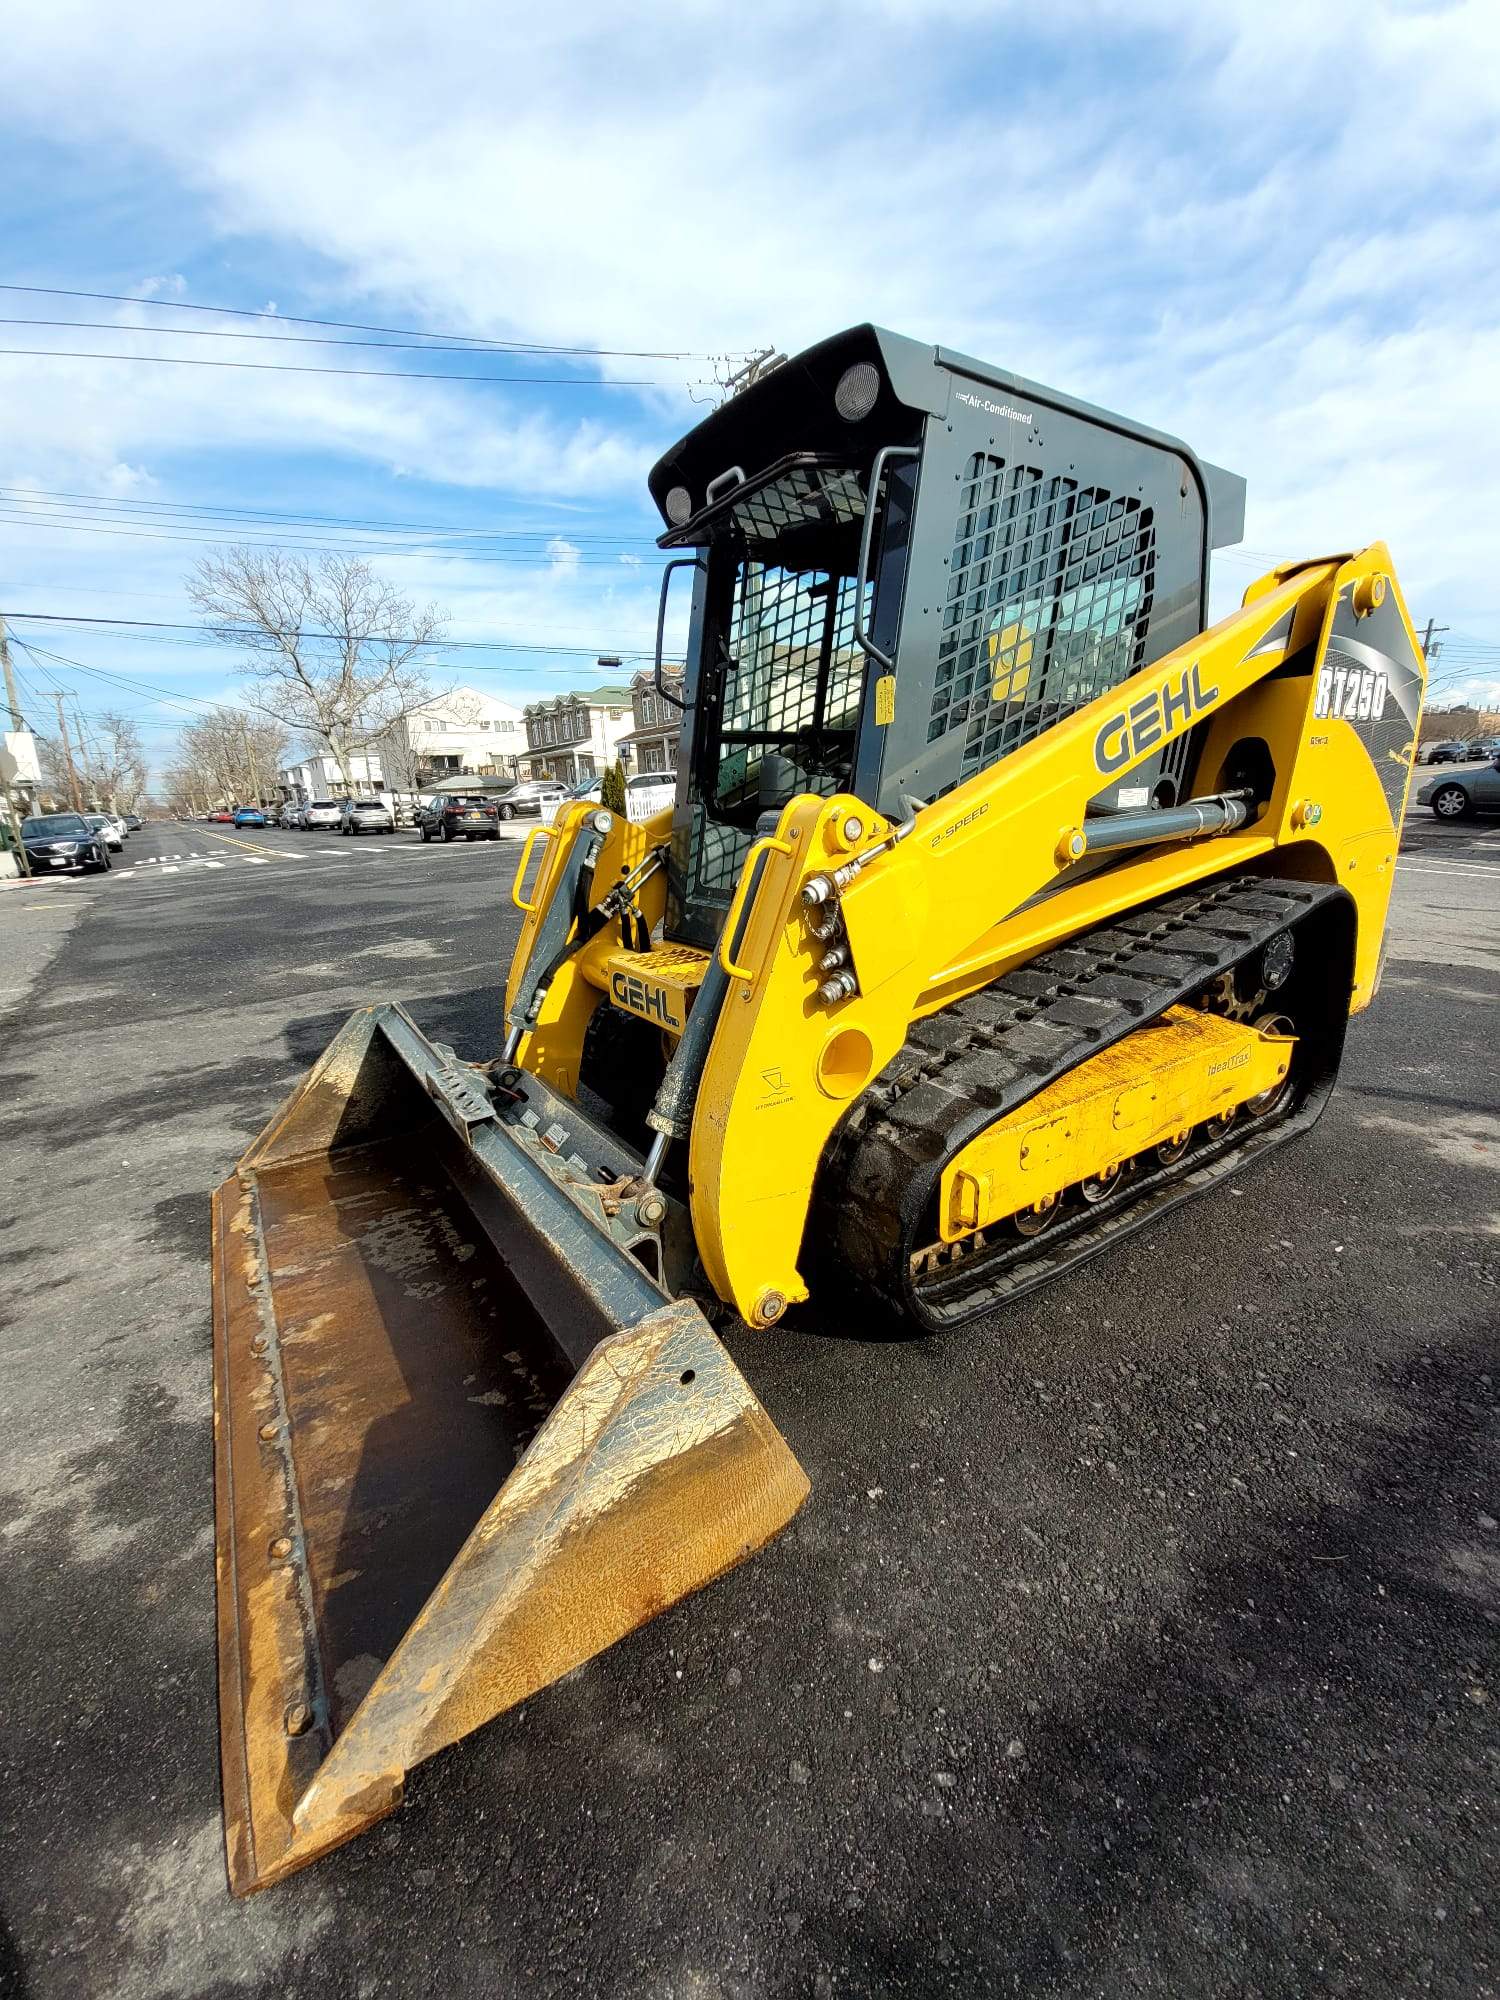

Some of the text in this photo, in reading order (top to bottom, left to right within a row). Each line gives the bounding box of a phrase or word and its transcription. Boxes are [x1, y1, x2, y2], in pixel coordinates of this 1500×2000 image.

[968, 395, 1033, 424] Air-Conditioned
[1314, 666, 1389, 720] RT250
[1094, 661, 1219, 775] GEHL
[931, 803, 989, 848] 2-SPEED
[612, 972, 680, 1027] GEHL
[1208, 1052, 1249, 1077] IdealTrax
